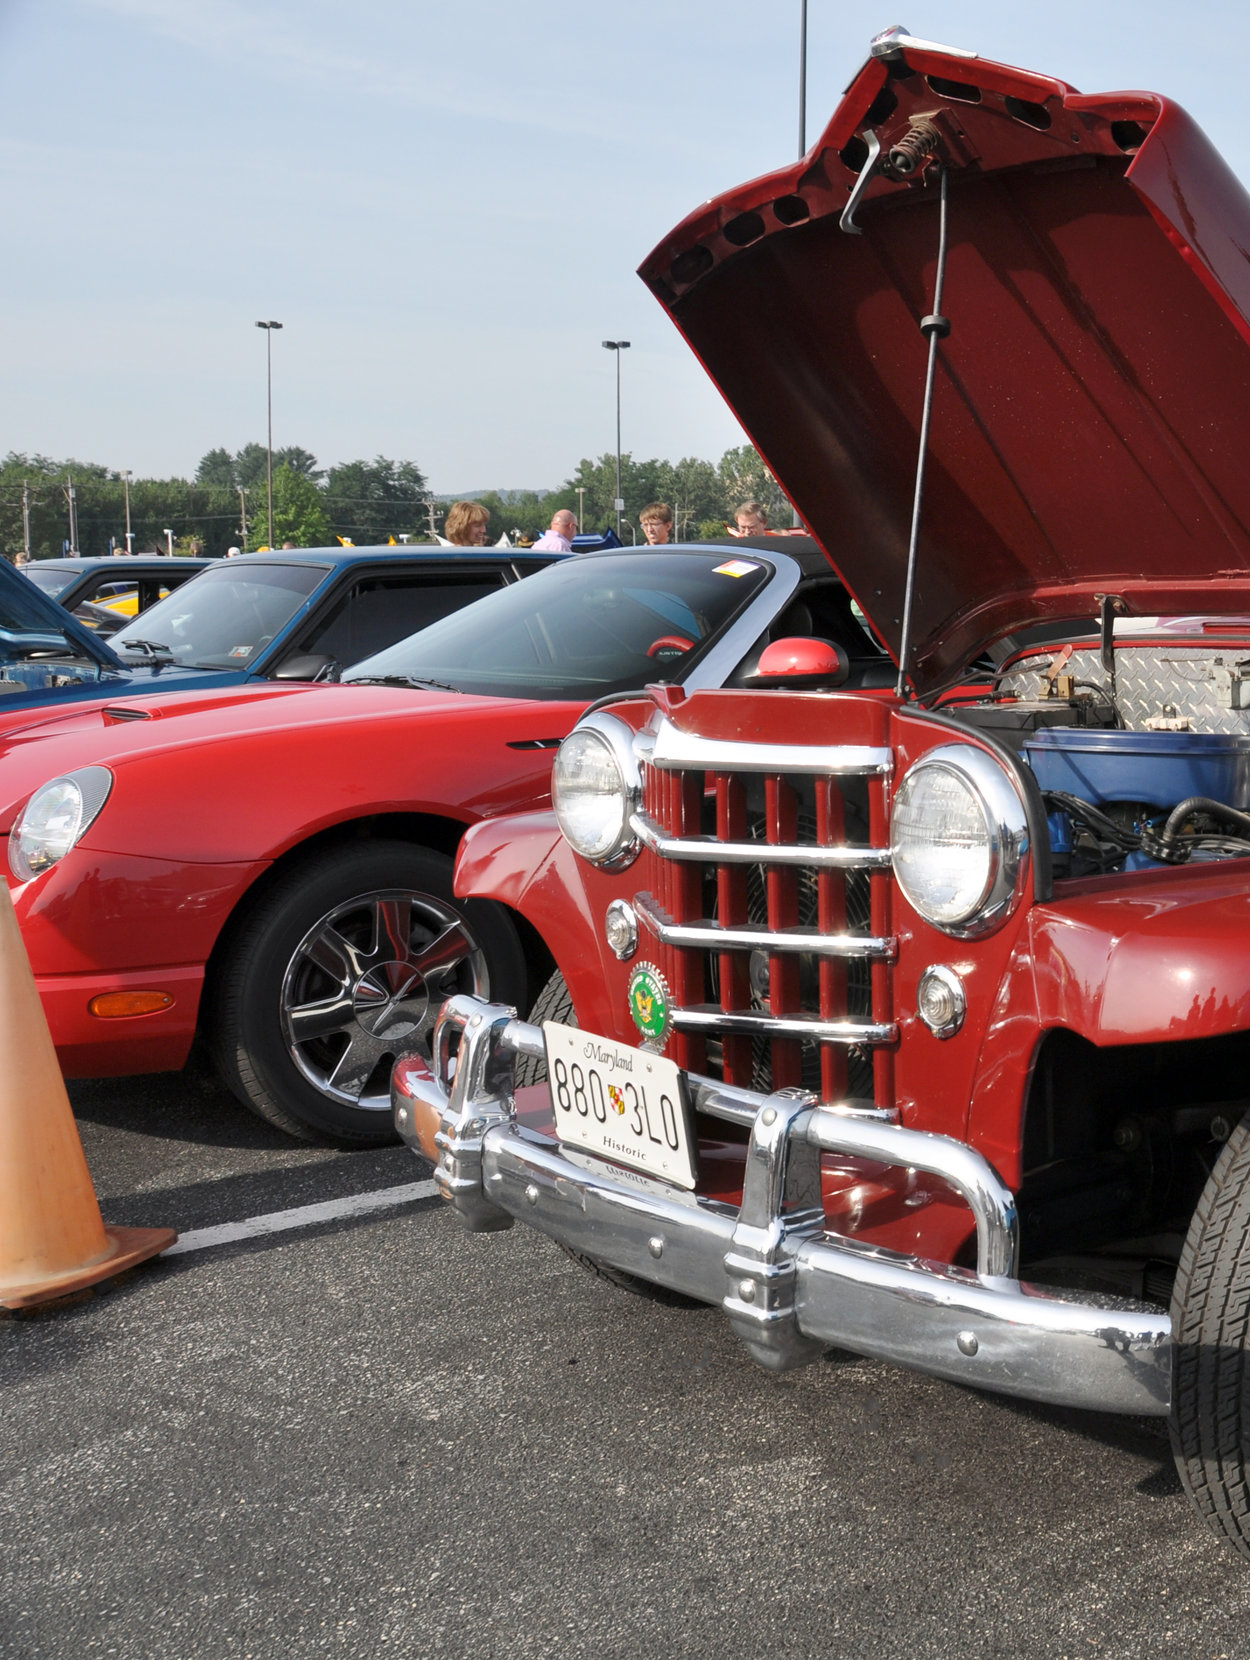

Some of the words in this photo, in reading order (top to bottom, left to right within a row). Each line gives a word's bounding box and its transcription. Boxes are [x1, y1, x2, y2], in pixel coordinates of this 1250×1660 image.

[584, 1042, 634, 1072] Maryland
[554, 1057, 607, 1124] 880
[602, 1135, 647, 1161] Historic
